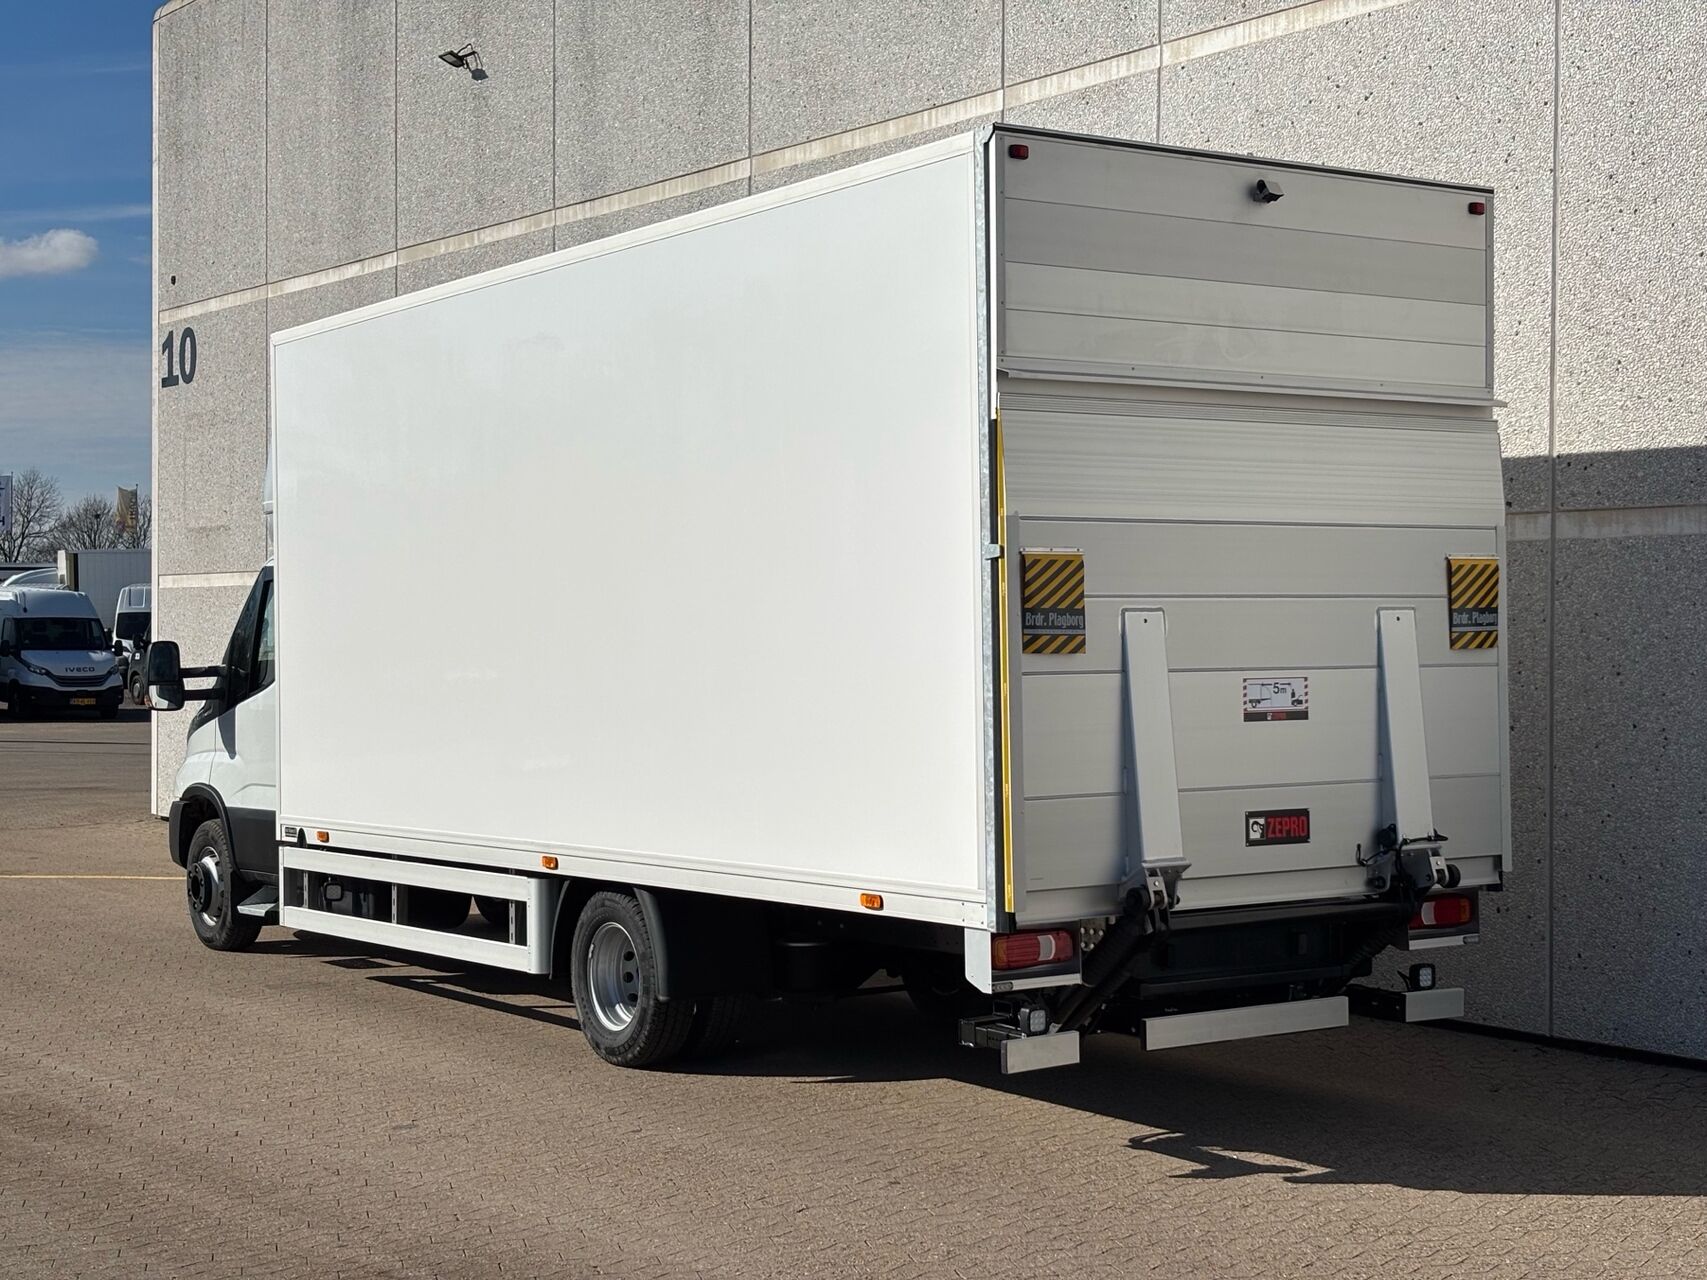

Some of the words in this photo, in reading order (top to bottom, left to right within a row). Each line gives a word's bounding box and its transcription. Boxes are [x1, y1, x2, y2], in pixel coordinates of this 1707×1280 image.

[162, 327, 197, 388] 10
[1025, 612, 1047, 626] Brdr.
[1048, 612, 1084, 628] Plagborg
[1267, 816, 1307, 838] ZEPRO
